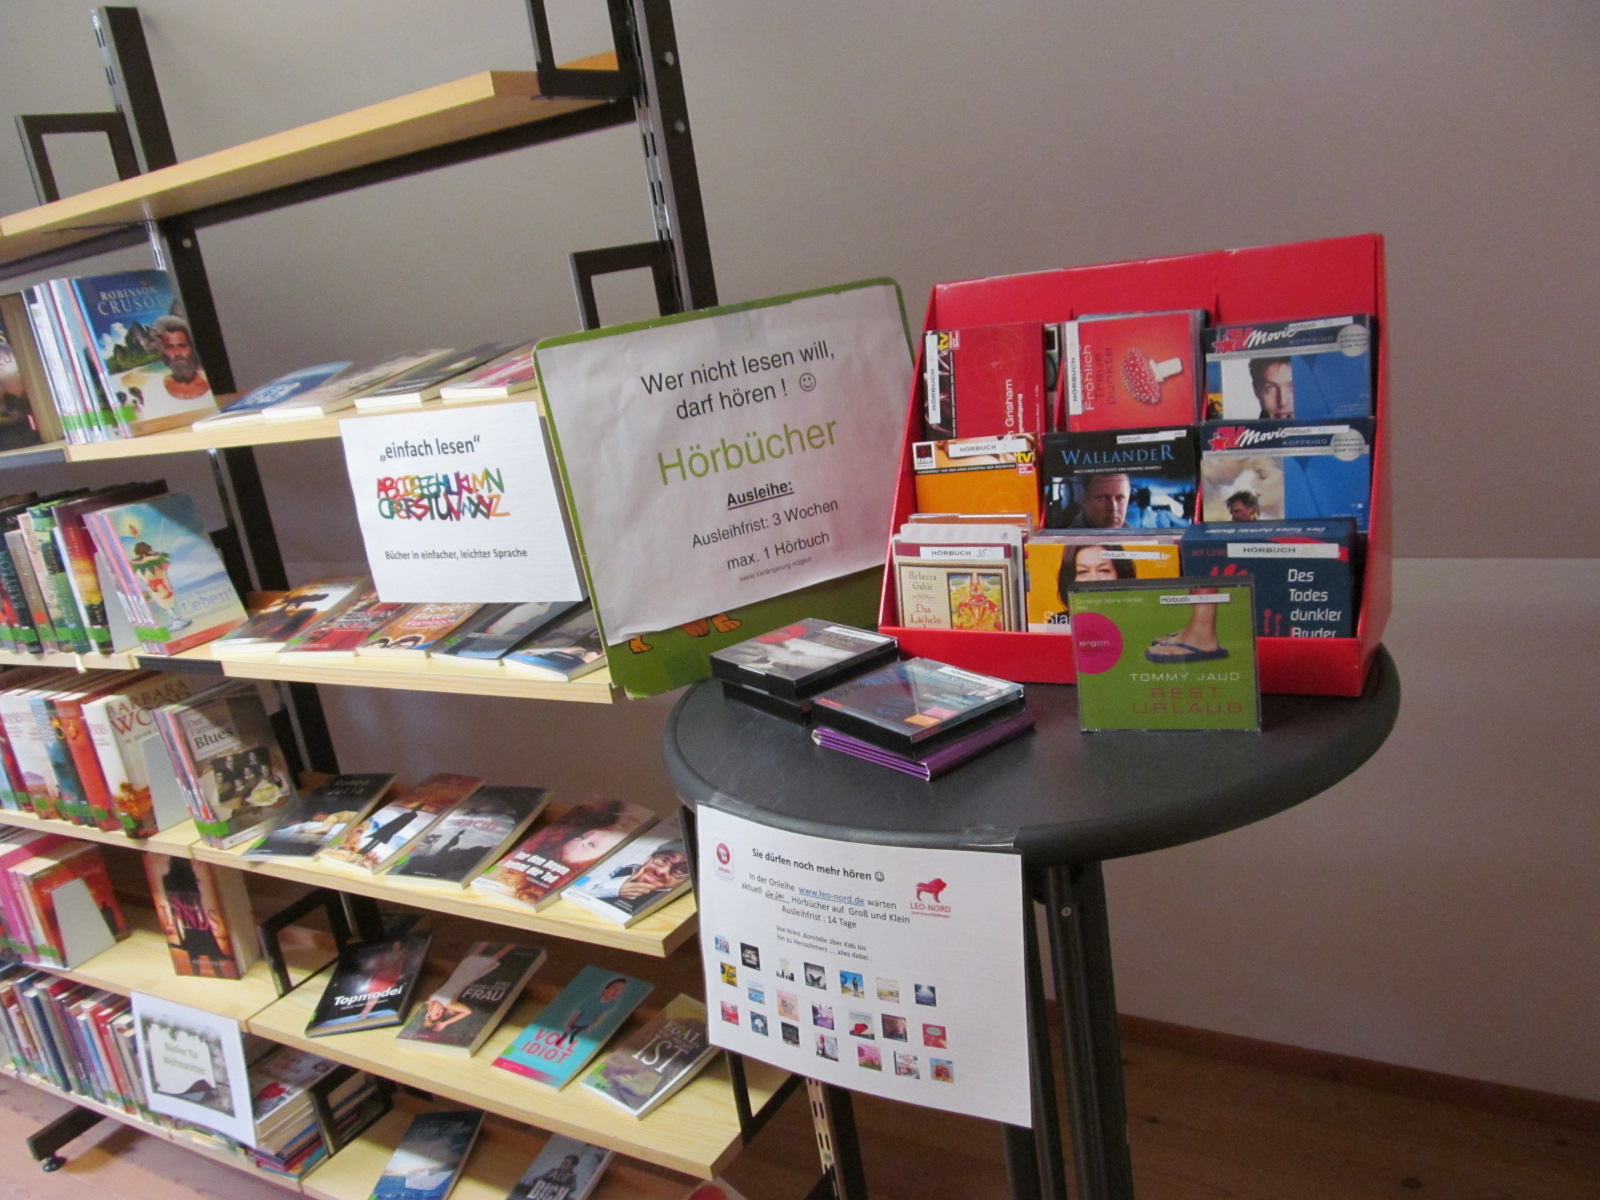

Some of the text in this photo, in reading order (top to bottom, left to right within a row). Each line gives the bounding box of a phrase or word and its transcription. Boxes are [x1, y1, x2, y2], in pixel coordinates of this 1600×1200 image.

[641, 340, 835, 395] Wer nicht lesen will,
[1083, 344, 1095, 410] Fröhlich
[1105, 347, 1115, 405] punkte
[676, 394, 714, 419] darf
[719, 384, 776, 410] hören
[1005, 379, 1014, 427] Grisham
[657, 420, 837, 486] Hörbücher
[1061, 444, 1175, 465] WALLANDER
[727, 481, 795, 508] Ausleihe:
[692, 500, 839, 548] Ausleihfrist: 3 Wochen
[385, 548, 528, 560] Bücher in einfacher, leichter Sprache
[727, 531, 830, 570] max. 1 Hörbuch
[909, 571, 937, 581] Rebecca
[1287, 568, 1315, 582] Des
[1289, 588, 1328, 602] Todes
[916, 604, 931, 613] Das
[1290, 608, 1342, 621] dunkler
[1292, 627, 1337, 638] Bruder
[1130, 672, 1240, 682] TOMMY JAUD
[1151, 686, 1222, 699] REST
[1133, 702, 1242, 714] URLAUB
[192, 727, 234, 750] Blues
[752, 848, 872, 880] Sie dürfen noch mehr hören
[742, 882, 763, 895] aktuell
[757, 874, 768, 884] der
[769, 878, 795, 891] Onleihe
[798, 887, 865, 906] www.leo-nord.de
[867, 899, 897, 909] warten
[791, 896, 830, 911] Hörbücher
[832, 904, 845, 914] auf
[849, 908, 868, 918] Groß
[870, 910, 887, 920] und
[889, 913, 911, 924] Klein
[910, 902, 951, 913] LEO-NORD
[828, 916, 837, 924] 14
[839, 918, 857, 929] Tage
[334, 984, 404, 1006] Topmodel
[462, 989, 507, 1001] FRAU
[534, 1029, 578, 1053] VOLL
[521, 1041, 571, 1064] IDIOT
[631, 1034, 689, 1073] IST
